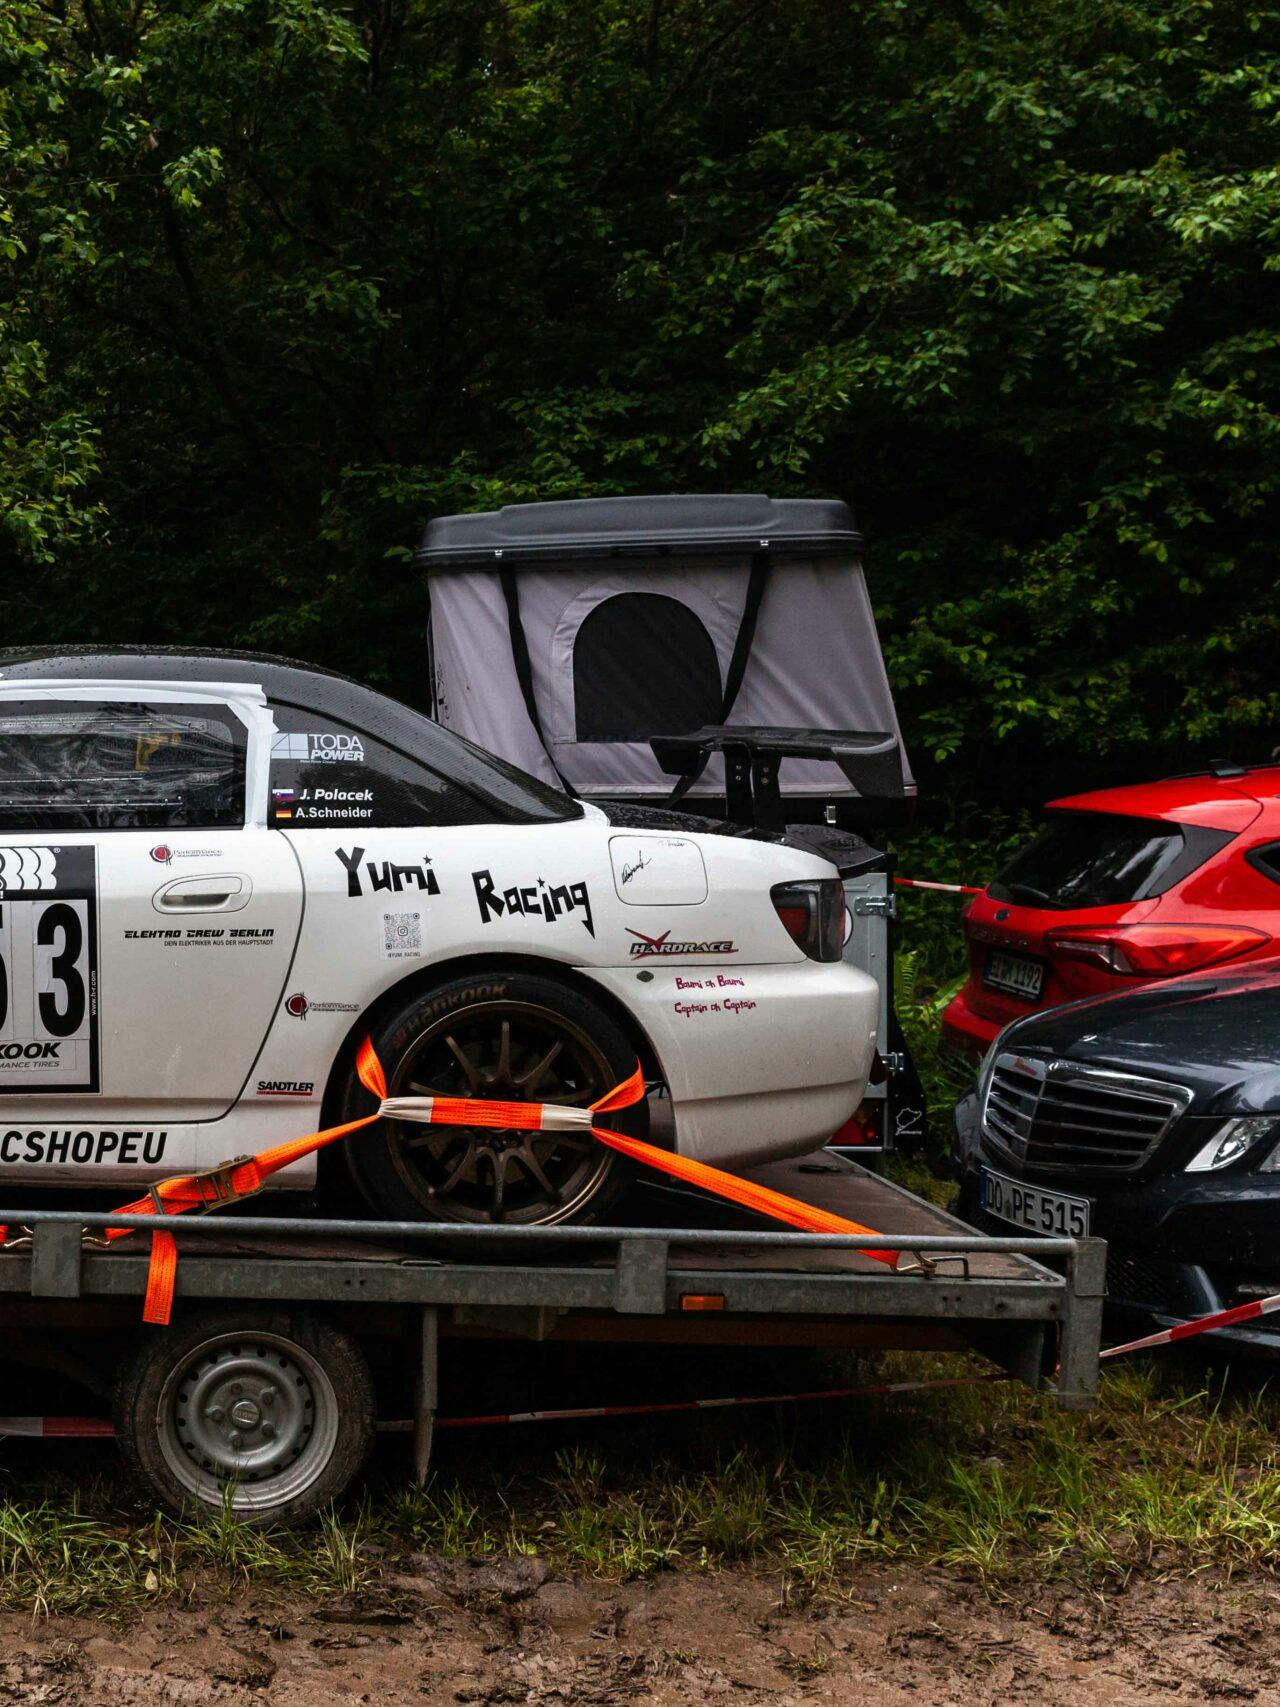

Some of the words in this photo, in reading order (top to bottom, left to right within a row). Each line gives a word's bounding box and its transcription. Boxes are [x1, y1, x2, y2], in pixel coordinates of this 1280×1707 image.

[308, 733, 364, 751] TODA
[310, 749, 365, 762] POWER
[299, 788, 311, 800] J.
[314, 788, 374, 801] Polacek
[295, 806, 373, 818] A.Schneider
[334, 846, 441, 898] Yumi
[471, 869, 596, 940] Racing
[186, 929, 225, 938] CREW
[228, 929, 275, 938] BERLIN
[631, 941, 734, 954] HARDRACE
[32, 1060, 60, 1068] TIRES
[257, 1080, 315, 1092] SANDTLER
[987, 1176, 1003, 1213] DO
[1012, 1187, 1036, 1226] PE
[1041, 1197, 1084, 1237] 515
